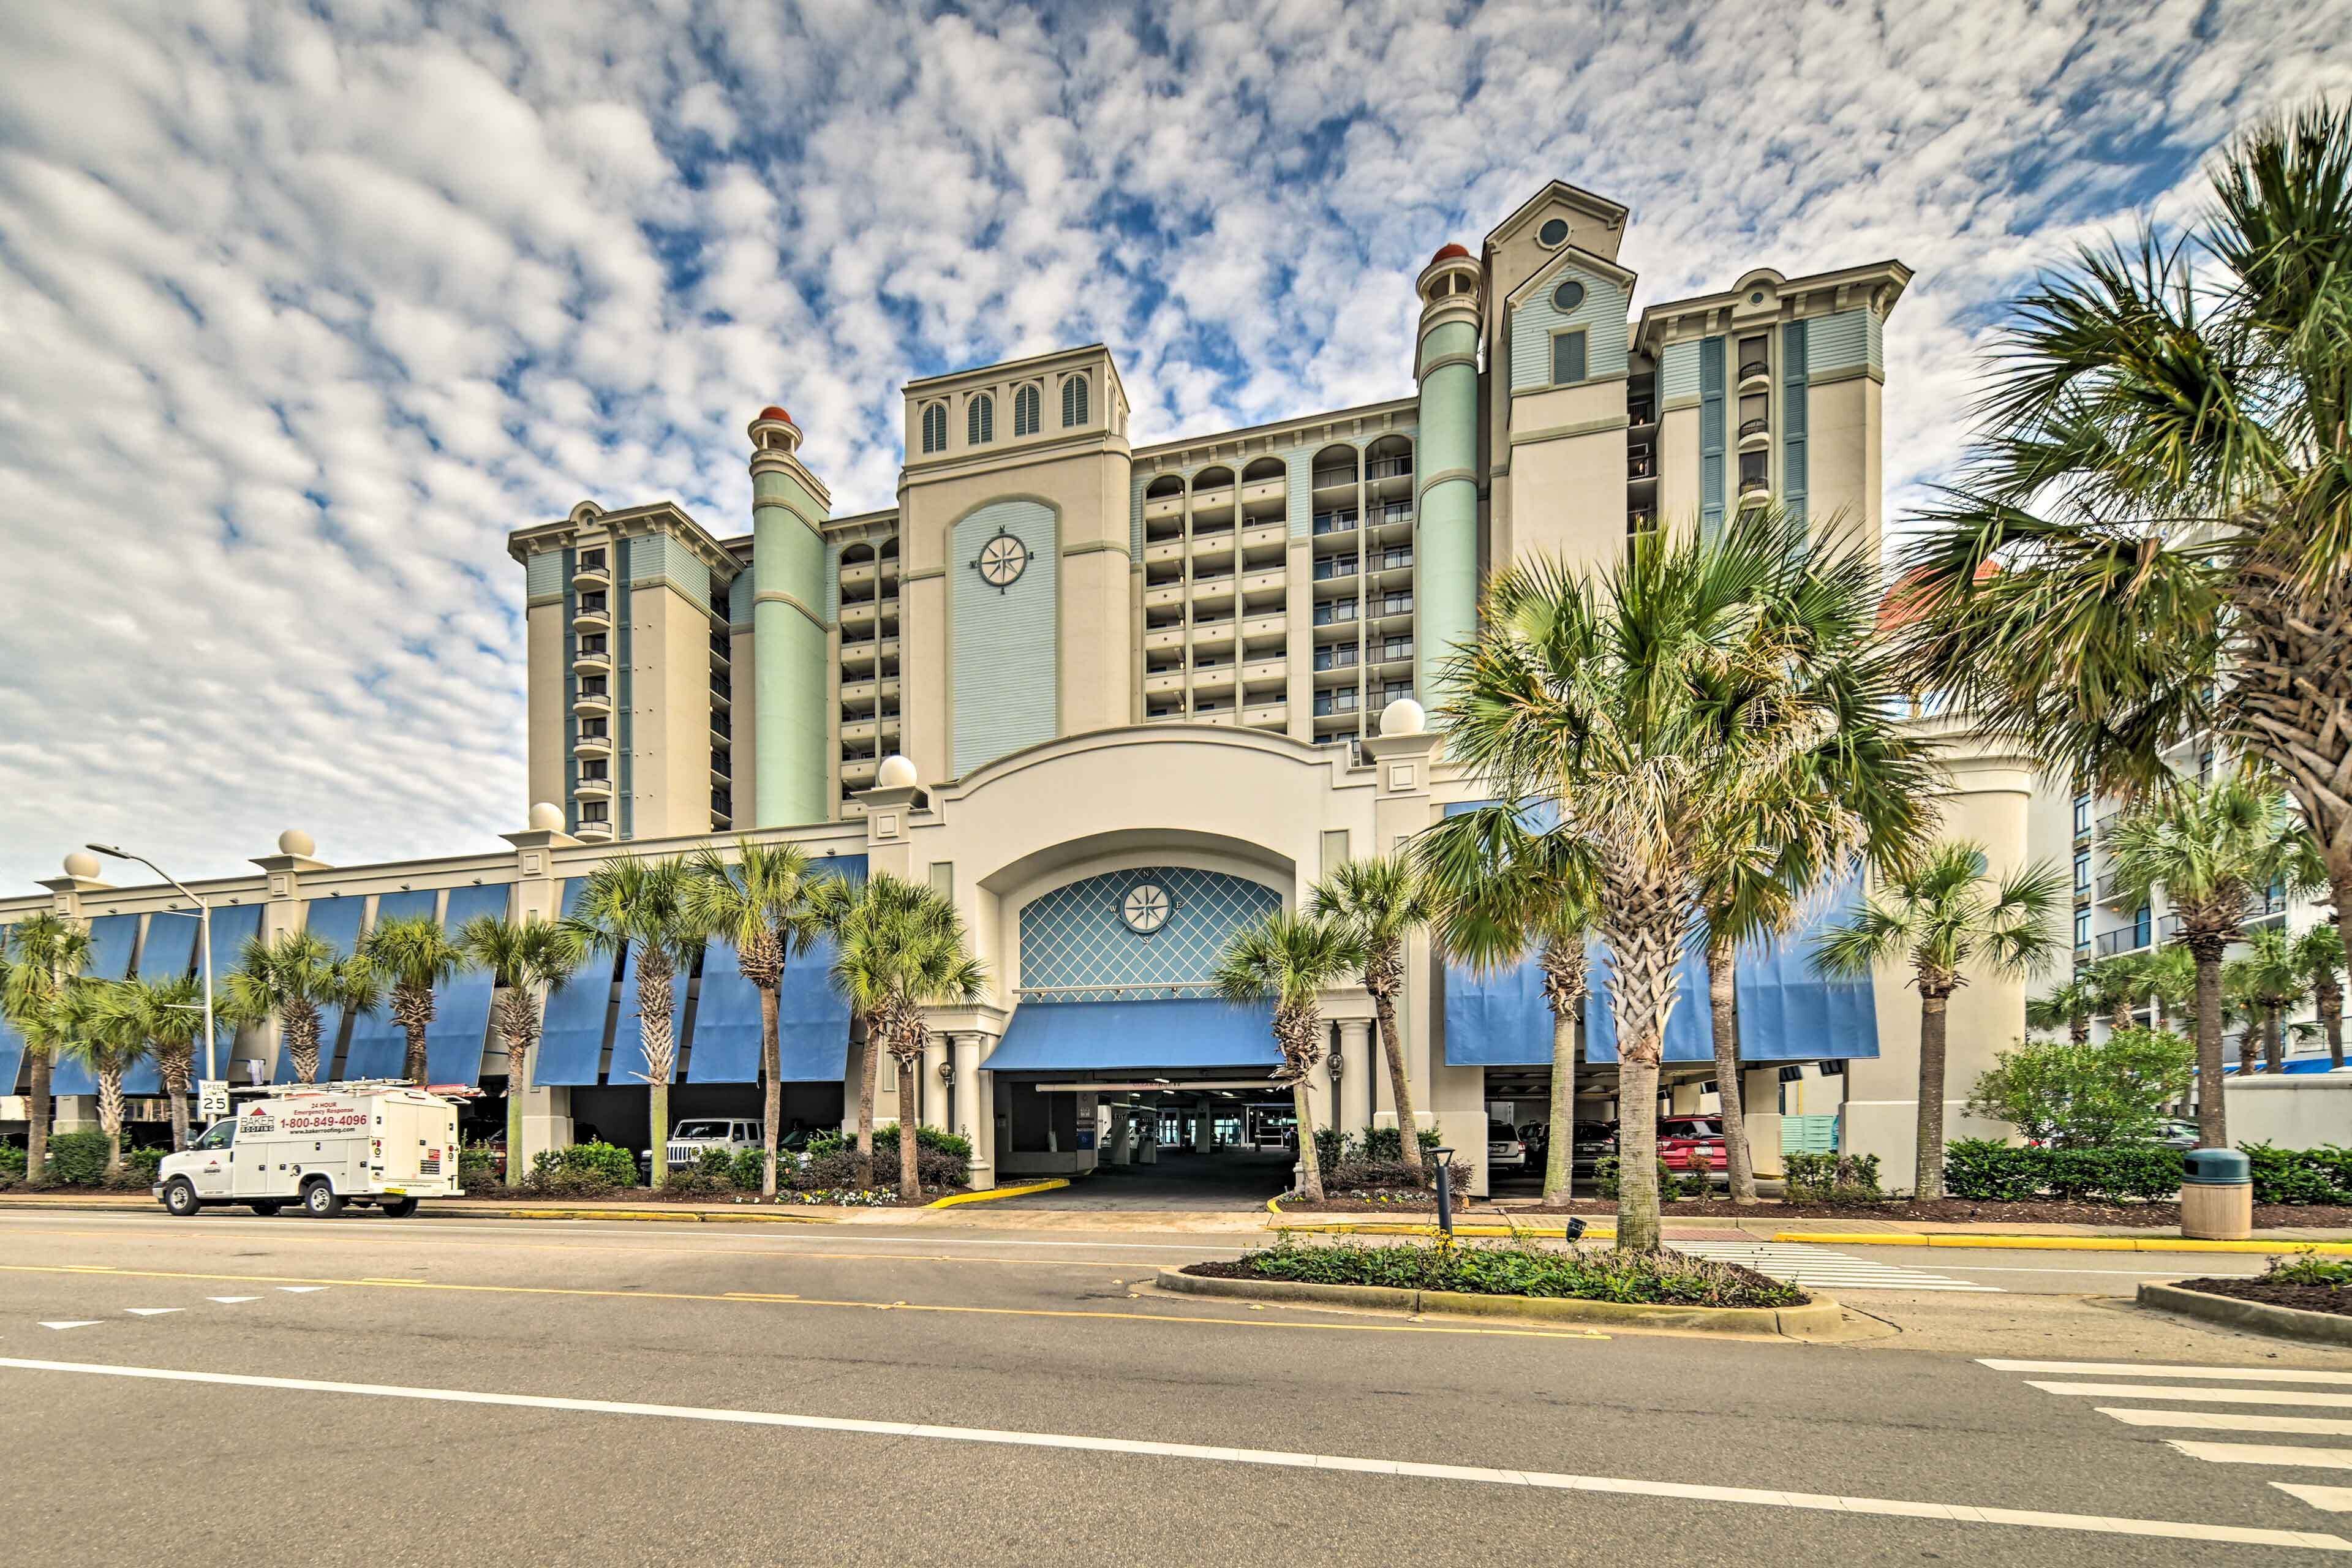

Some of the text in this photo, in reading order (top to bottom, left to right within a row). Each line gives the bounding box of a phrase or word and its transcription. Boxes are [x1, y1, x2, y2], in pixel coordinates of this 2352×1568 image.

[203, 1098, 225, 1109] 25
[240, 1116, 274, 1126] BAKER
[280, 1115, 367, 1128] 1-800-849-4096
